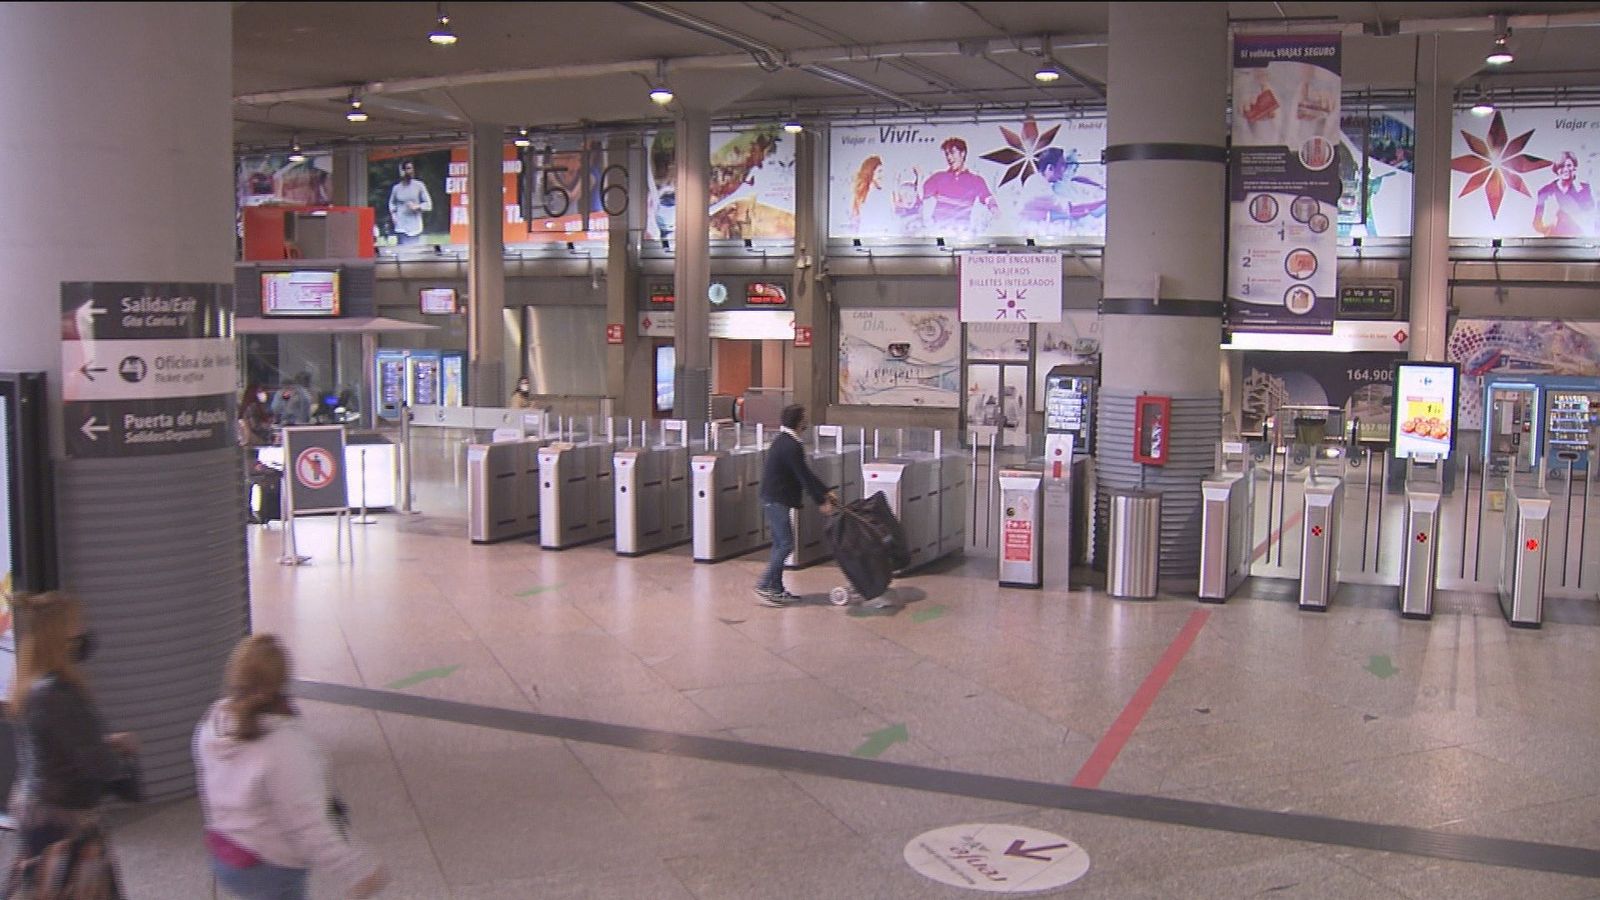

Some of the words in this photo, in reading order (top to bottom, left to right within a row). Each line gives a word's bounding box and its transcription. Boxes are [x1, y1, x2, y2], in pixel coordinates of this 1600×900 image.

[1304, 46, 1336, 57] SEGURO
[1555, 118, 1588, 131] Viajar
[968, 255, 994, 264] PUNTO
[996, 255, 1006, 264] DE
[1008, 255, 1058, 264] ENCUENTRO
[1242, 256, 1251, 268] 2
[993, 266, 1031, 276] VIAJEROS
[969, 278, 1003, 287] BILLETES
[1004, 278, 1056, 287] INTEGRADOS
[154, 355, 199, 370] Oficina
[123, 412, 174, 430] Puerta
[176, 411, 194, 426] de
